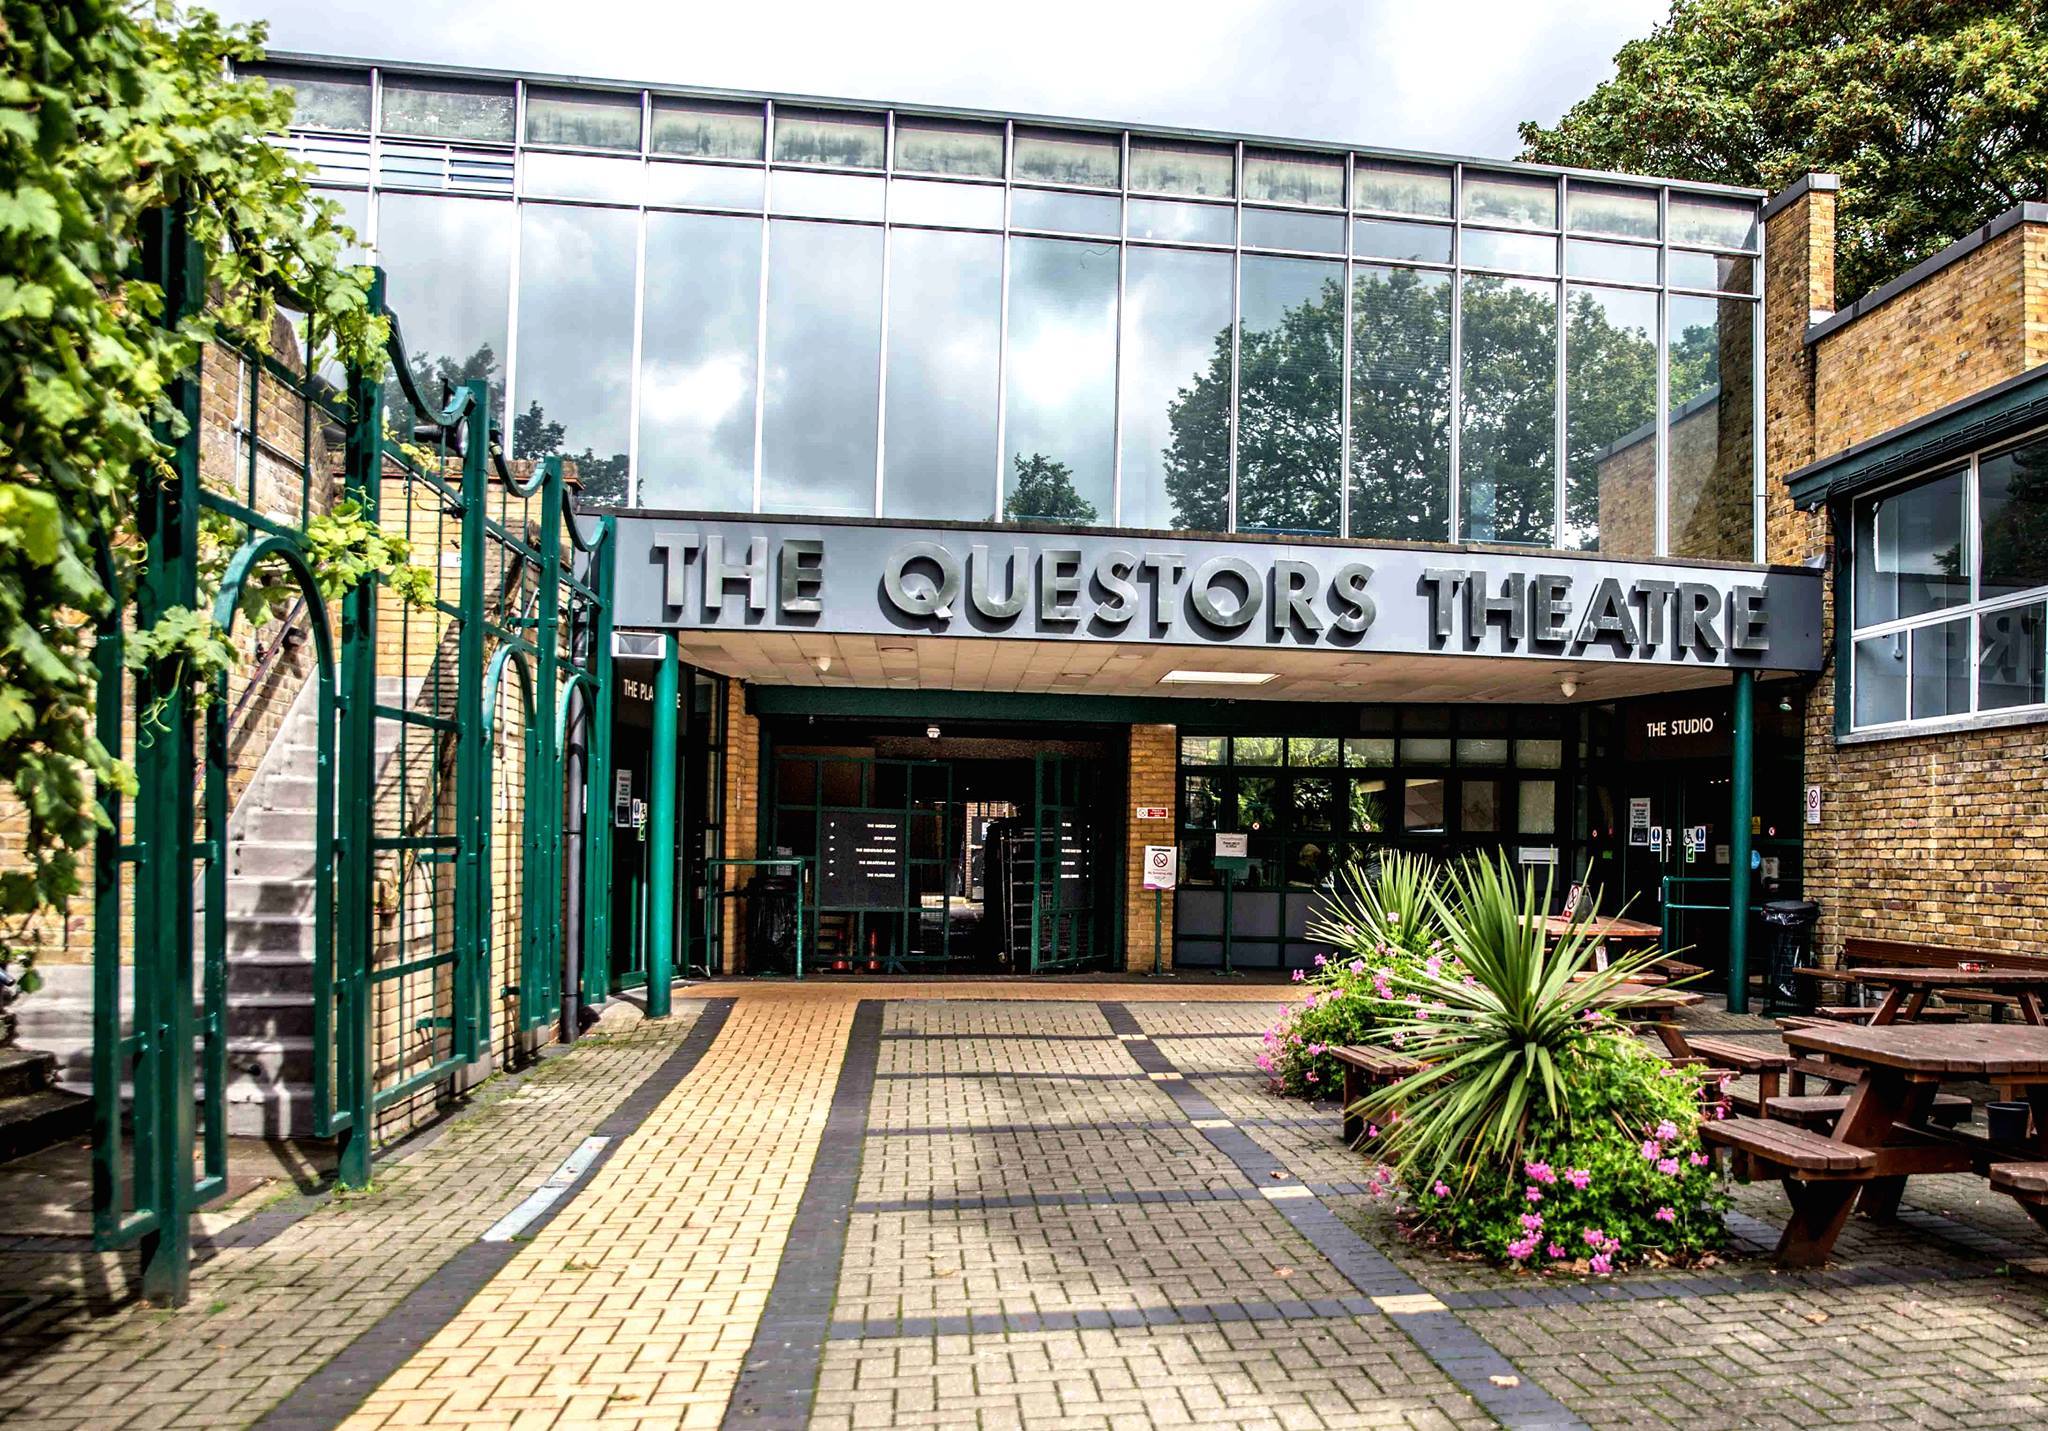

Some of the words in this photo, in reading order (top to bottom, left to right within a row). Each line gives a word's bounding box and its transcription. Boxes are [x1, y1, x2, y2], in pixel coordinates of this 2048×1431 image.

[652, 531, 824, 614] THE
[882, 540, 1377, 634] QUESTORS
[1421, 567, 1771, 651] THEATRE
[624, 678, 638, 698] THE
[1646, 721, 1667, 737] THE
[1671, 717, 1714, 735] STUDIO
